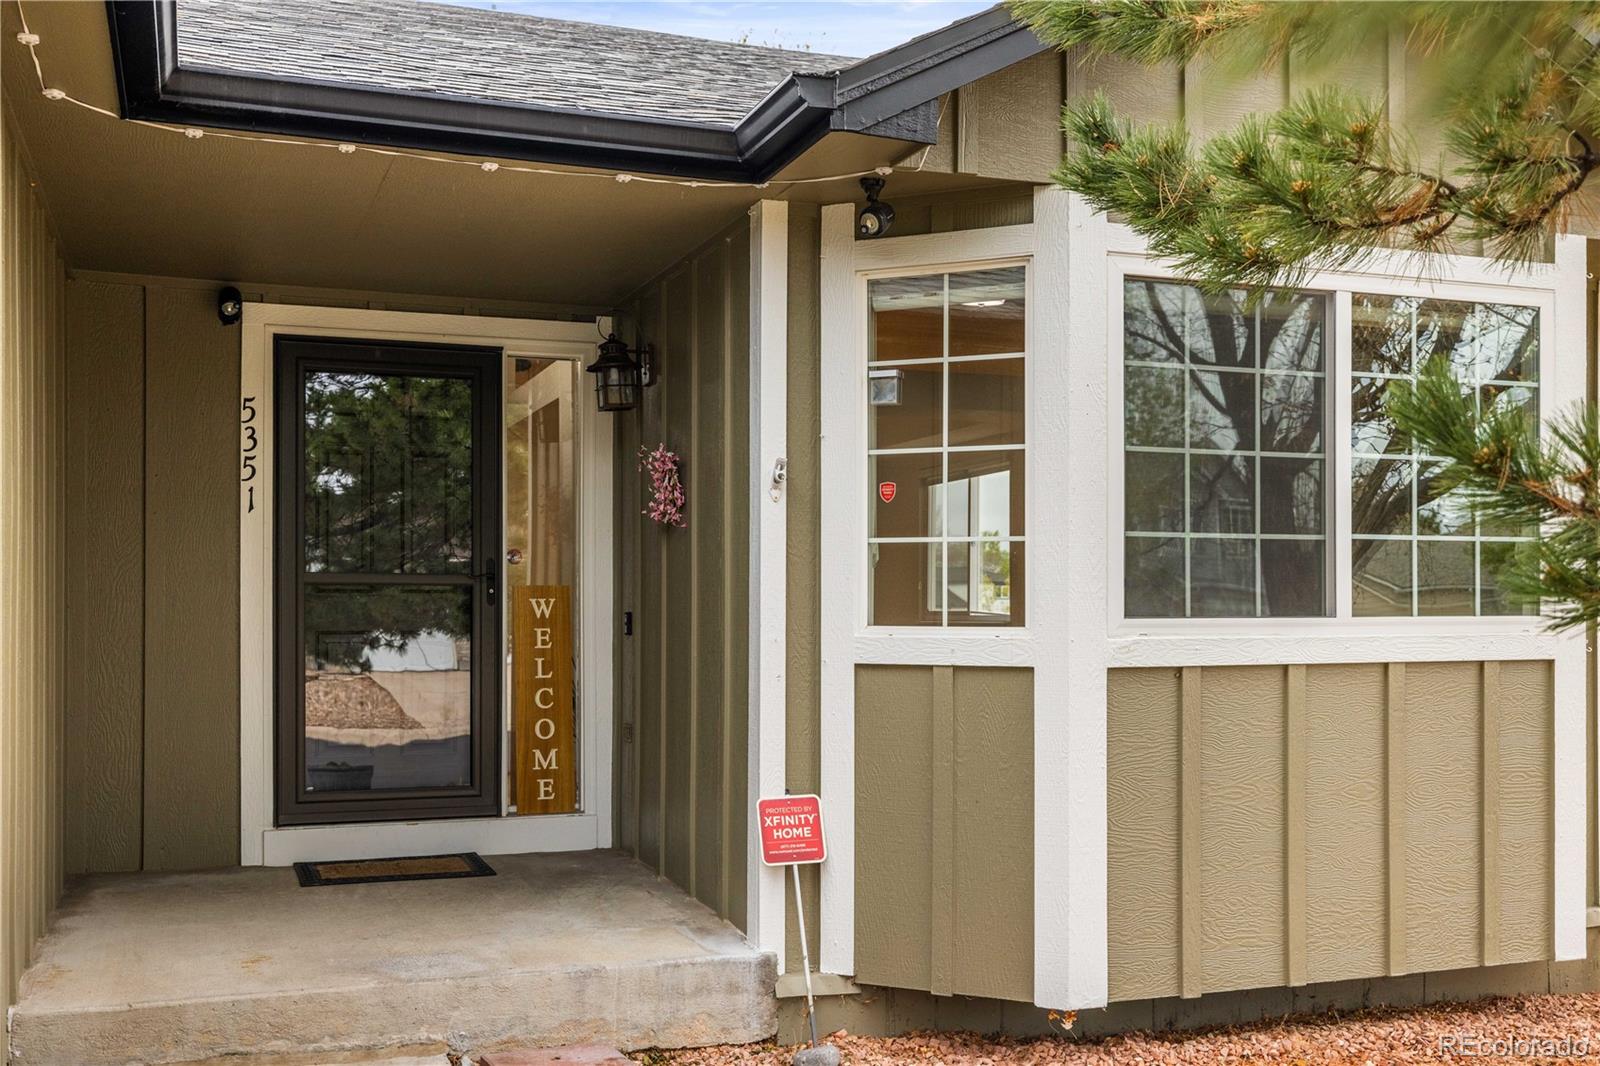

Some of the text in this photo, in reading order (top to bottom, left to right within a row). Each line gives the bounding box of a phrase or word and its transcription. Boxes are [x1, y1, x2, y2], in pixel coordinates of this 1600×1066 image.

[241, 396, 258, 514] 5351
[529, 598, 559, 801] WELCOME
[764, 814, 816, 827] XFINITY
[773, 827, 812, 839] HOME
